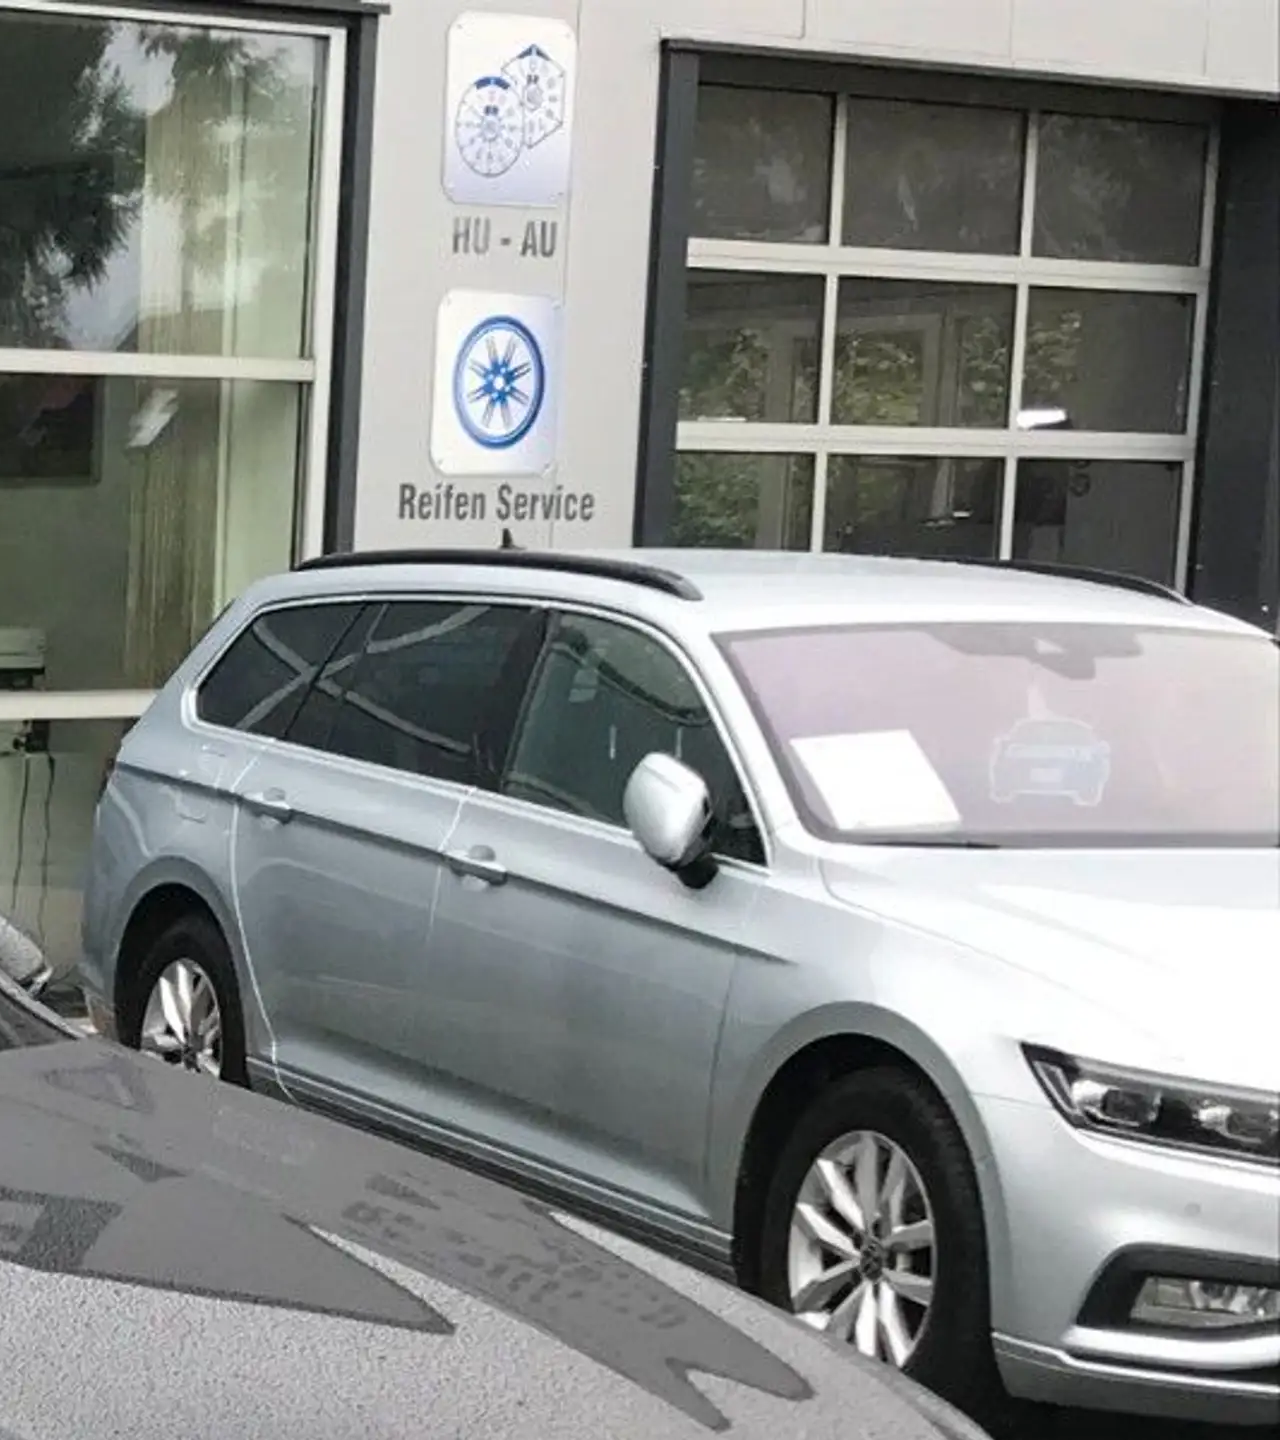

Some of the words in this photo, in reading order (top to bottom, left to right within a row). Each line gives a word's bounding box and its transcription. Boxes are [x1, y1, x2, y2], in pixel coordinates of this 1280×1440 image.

[452, 216, 491, 255] HU
[520, 220, 558, 258] AU
[398, 482, 487, 521] Reifen
[495, 482, 596, 521] Service
